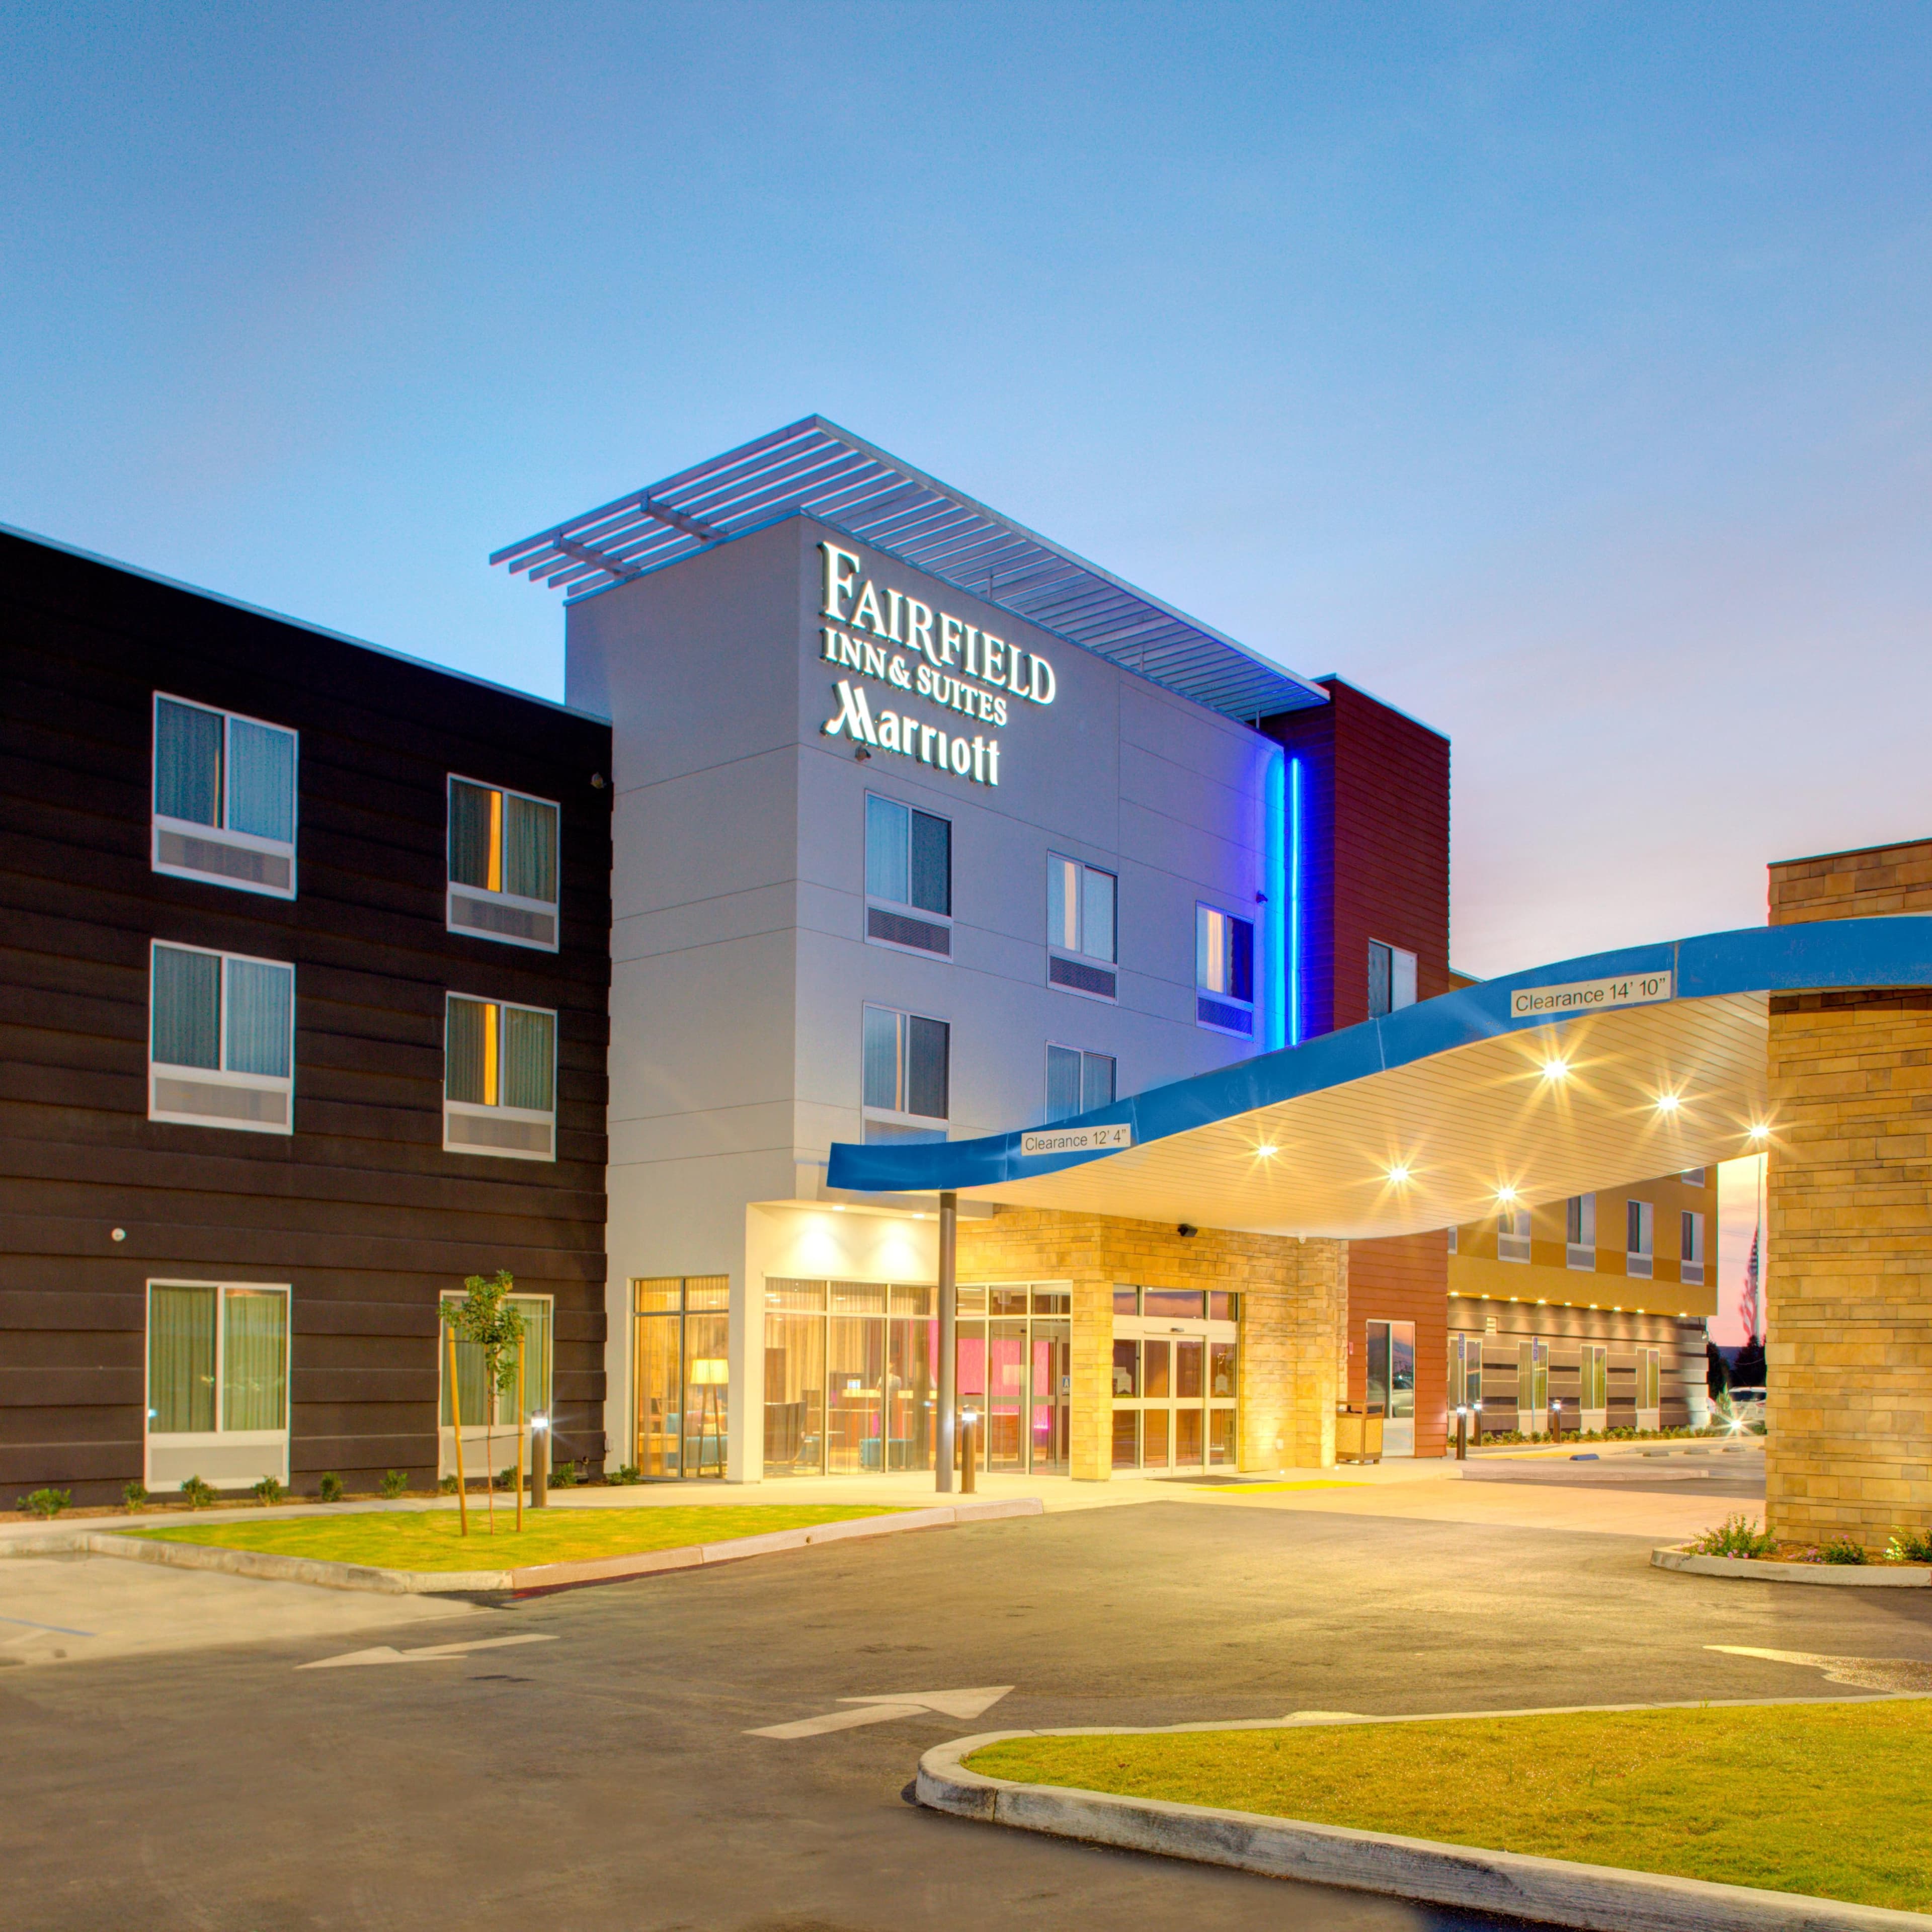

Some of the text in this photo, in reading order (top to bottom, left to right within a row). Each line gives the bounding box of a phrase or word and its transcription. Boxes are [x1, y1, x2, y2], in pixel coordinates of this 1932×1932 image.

[822, 541, 1056, 705] FAIRFIELD
[917, 664, 1007, 727] SUITES
[824, 680, 1000, 786] Marriott
[1515, 989, 1604, 1011] Clearance
[1025, 1136, 1087, 1151] Clearance
